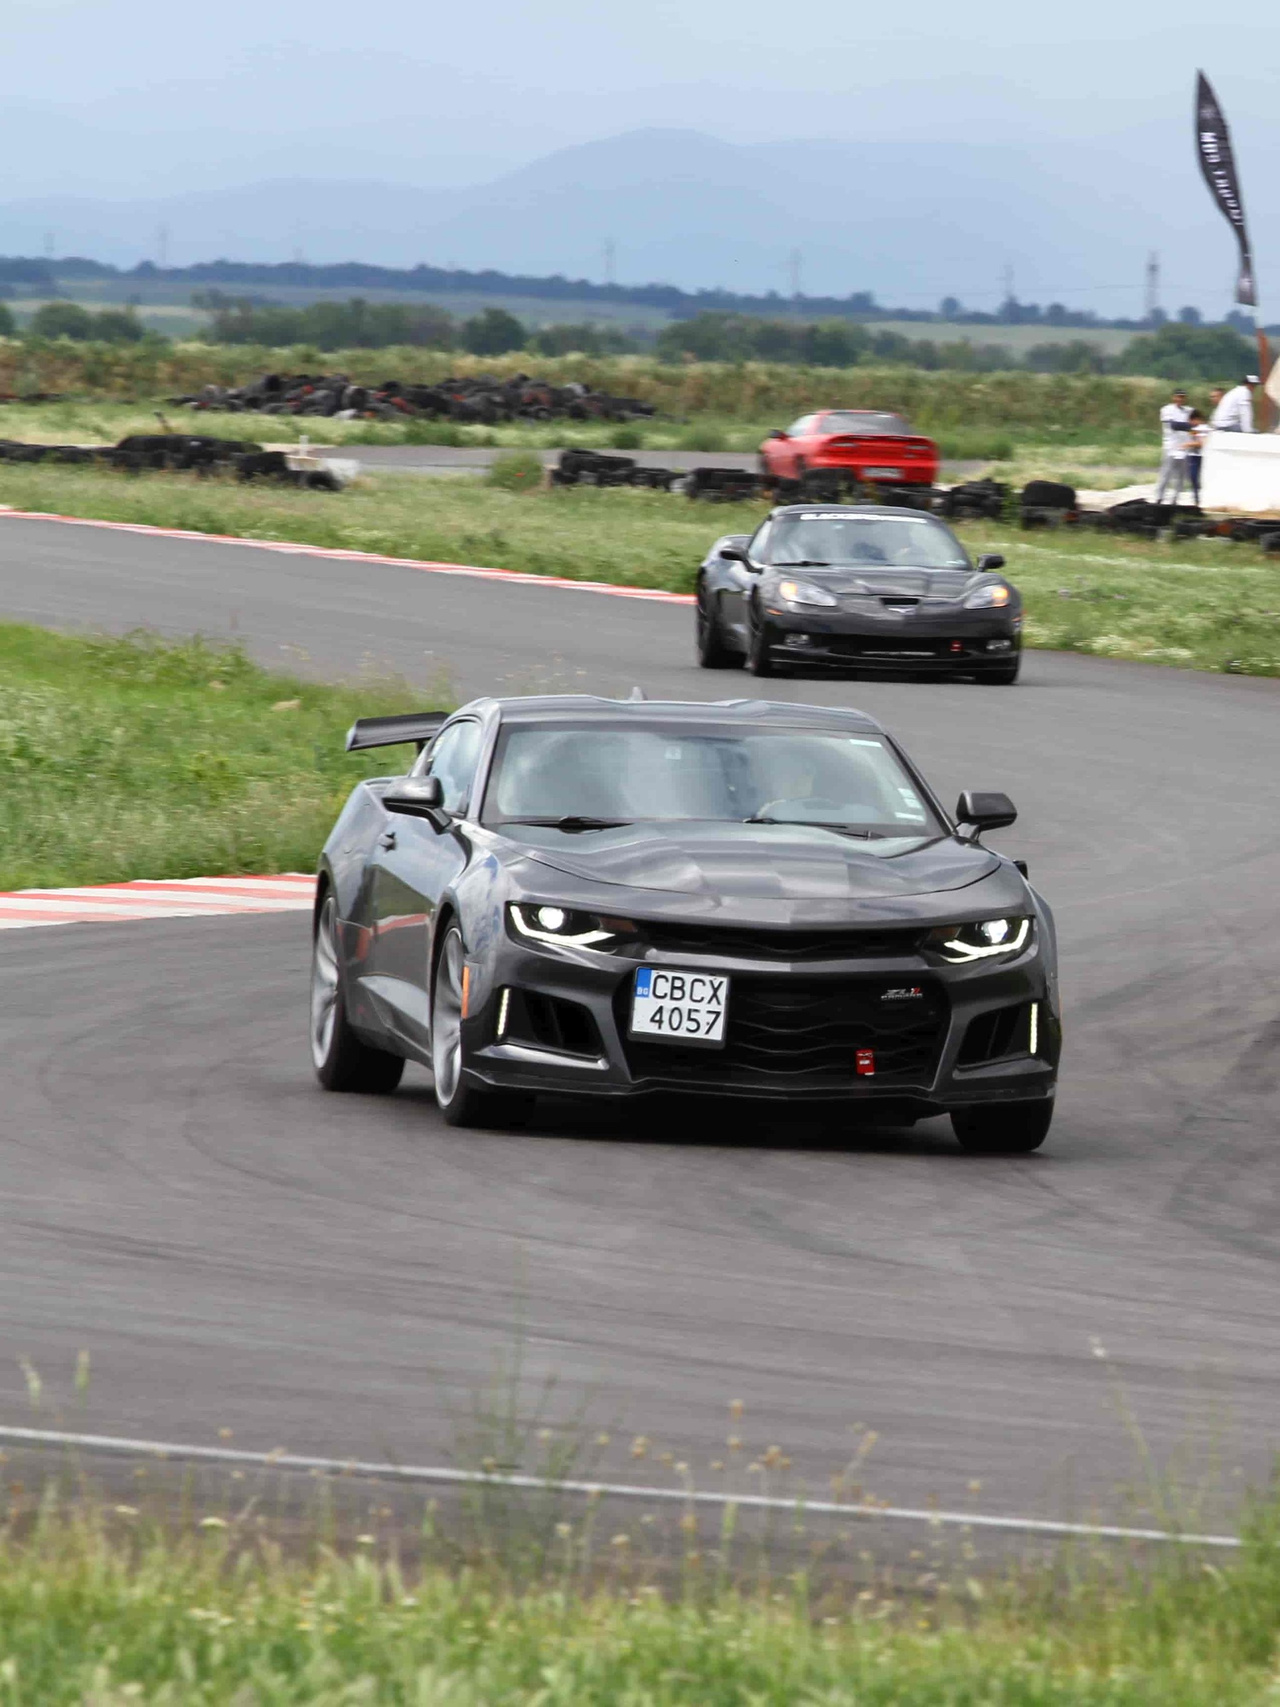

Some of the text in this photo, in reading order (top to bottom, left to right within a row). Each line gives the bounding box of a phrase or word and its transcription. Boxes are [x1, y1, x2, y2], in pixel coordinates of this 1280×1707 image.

[636, 986, 649, 995] BG
[652, 974, 724, 1006] CBCX
[649, 1005, 722, 1036] 4057
